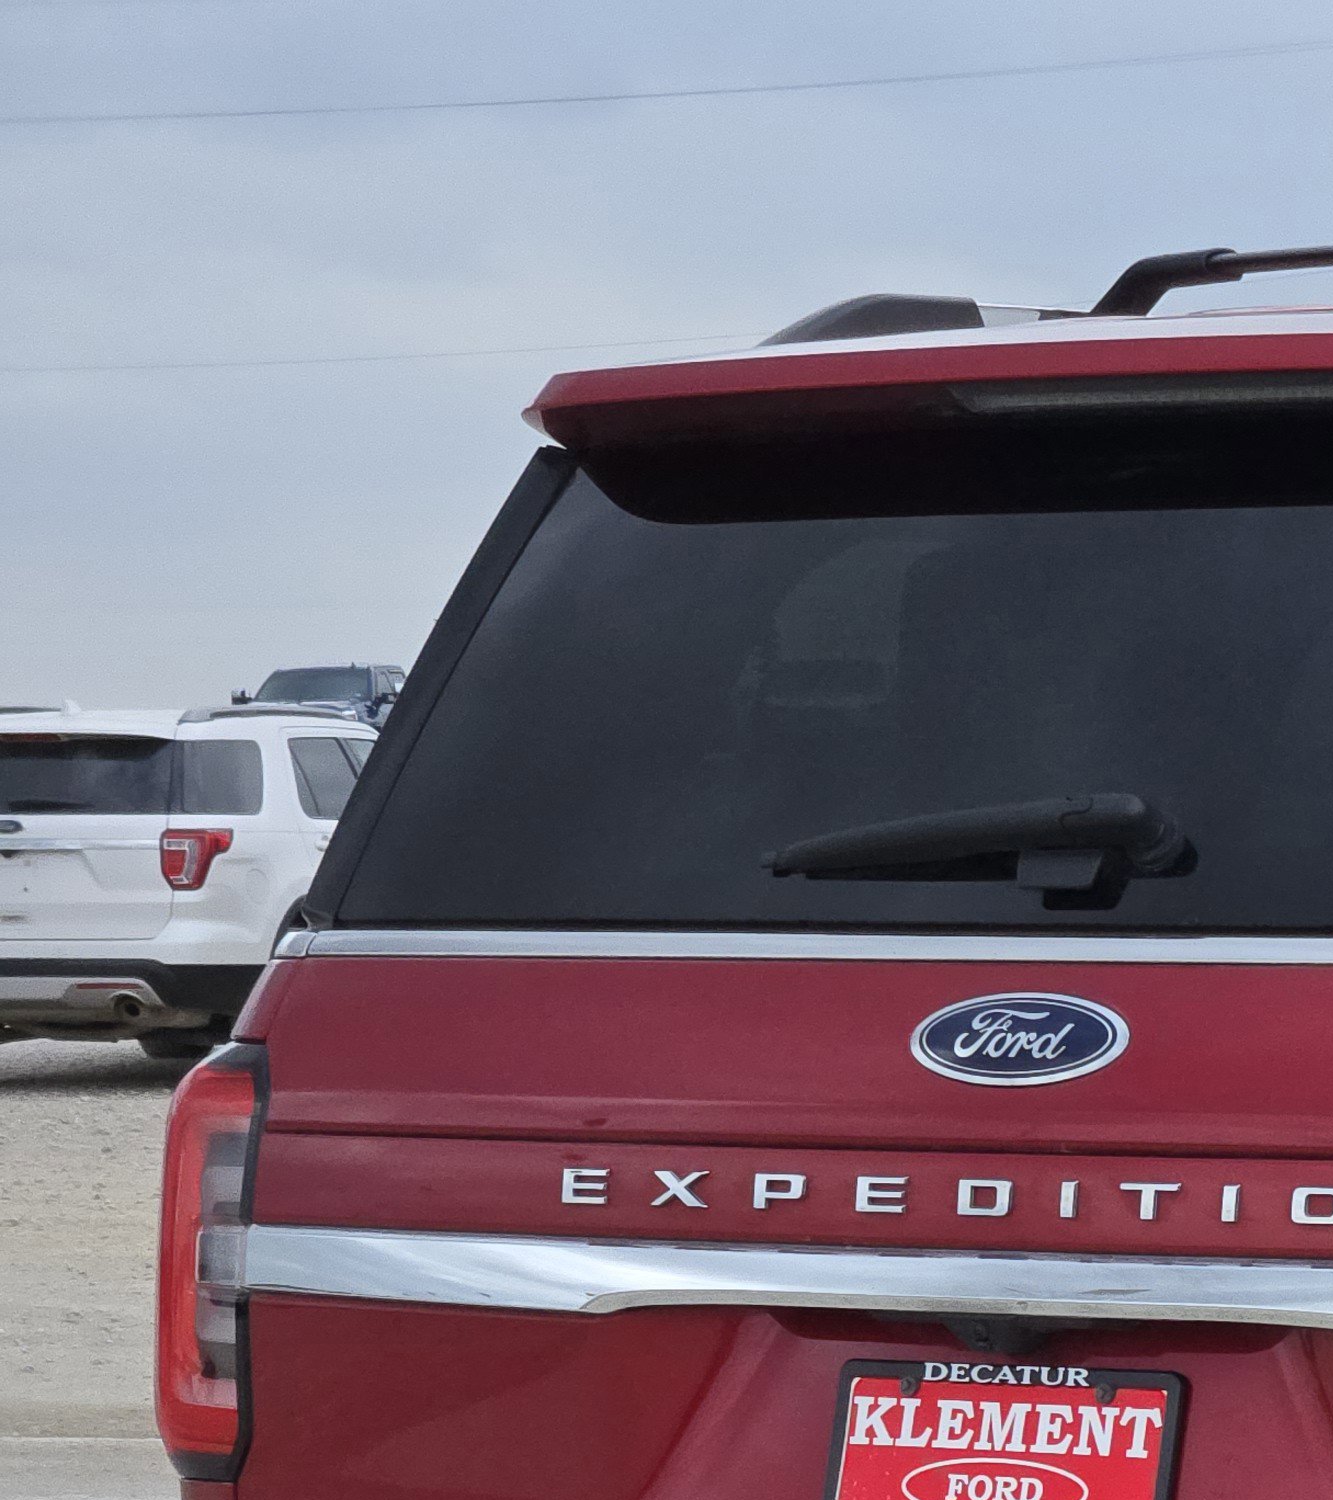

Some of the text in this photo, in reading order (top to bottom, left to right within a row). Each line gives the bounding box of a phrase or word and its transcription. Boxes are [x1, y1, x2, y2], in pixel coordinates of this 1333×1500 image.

[953, 1008, 1075, 1060] Ford
[923, 1362, 1090, 1387] DECATUR
[849, 1396, 1163, 1459] KLEMENT
